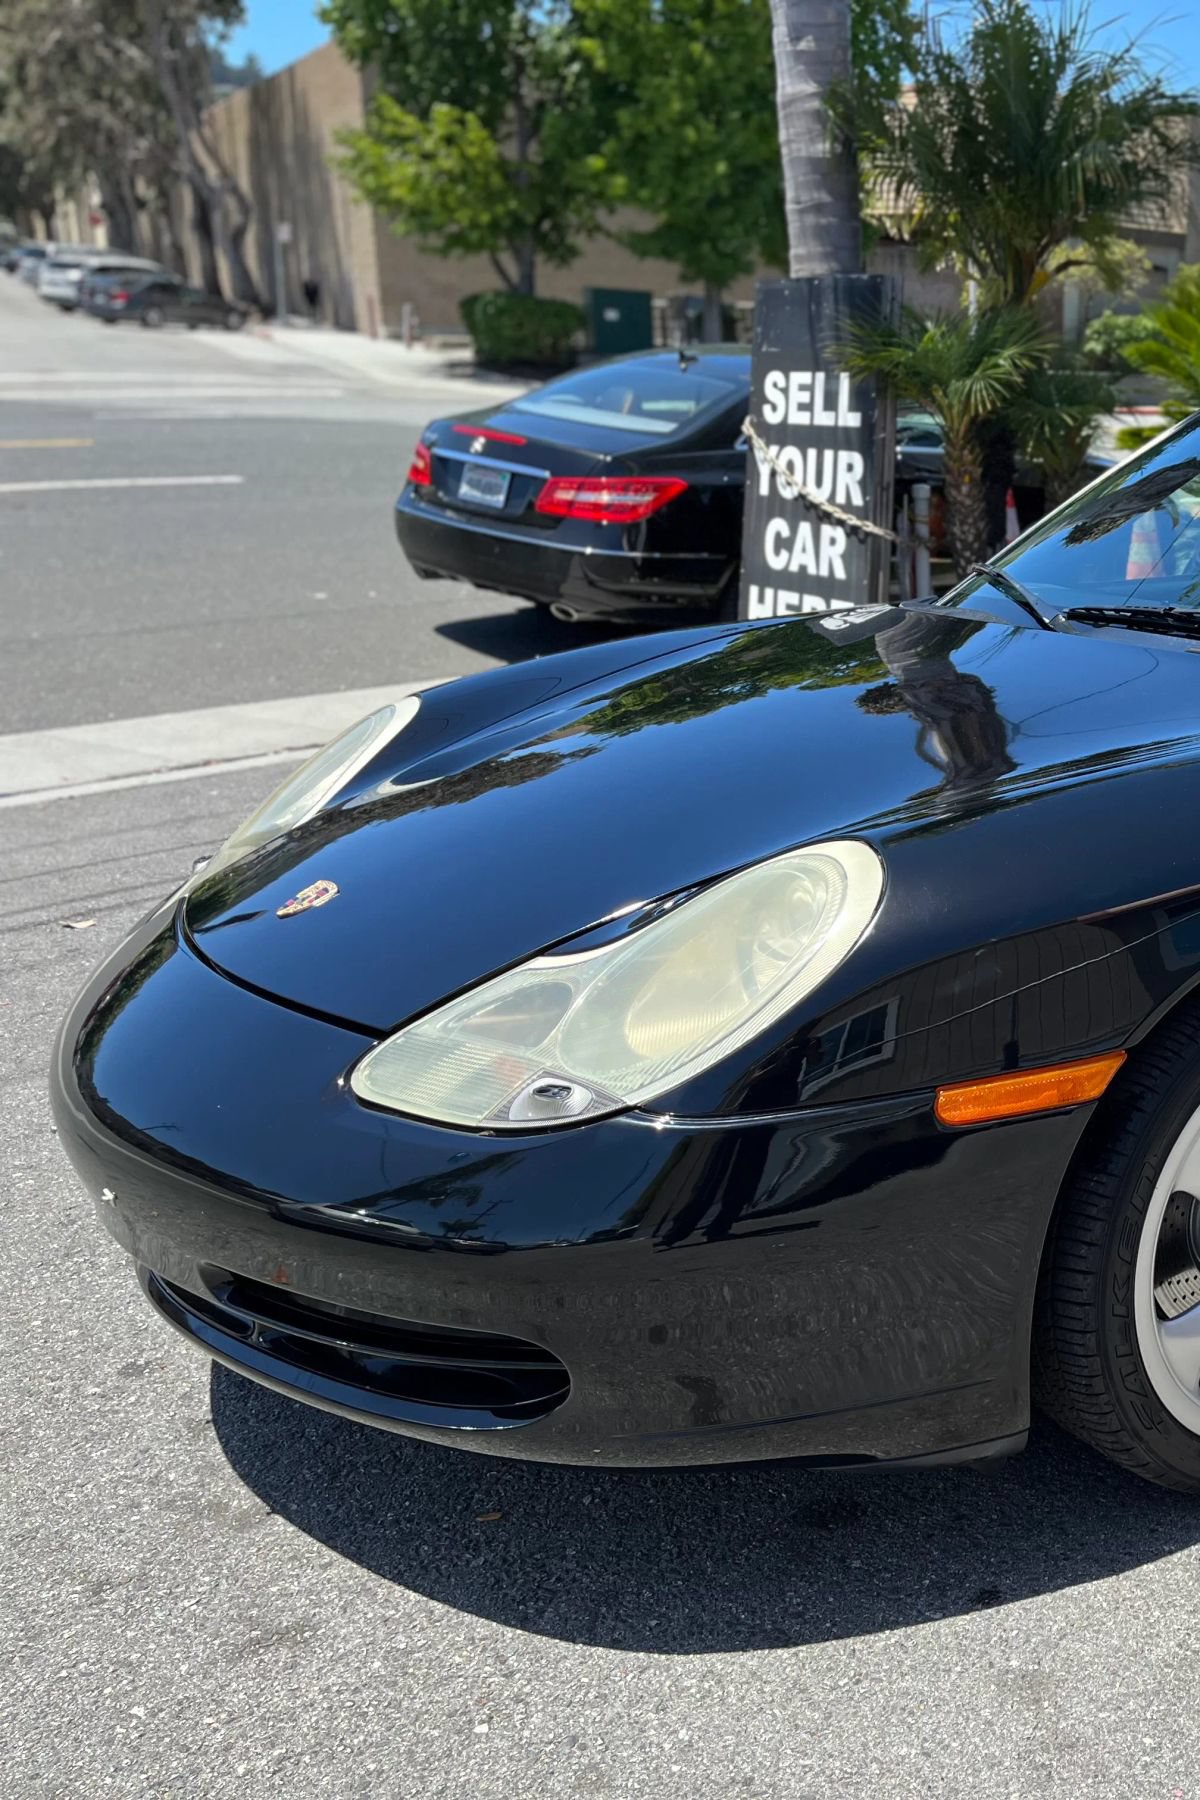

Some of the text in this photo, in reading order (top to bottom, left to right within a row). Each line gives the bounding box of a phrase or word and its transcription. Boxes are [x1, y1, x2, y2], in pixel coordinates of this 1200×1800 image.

[762, 370, 862, 427] SELL
[755, 446, 864, 506] YOUR
[764, 517, 847, 580] CAR
